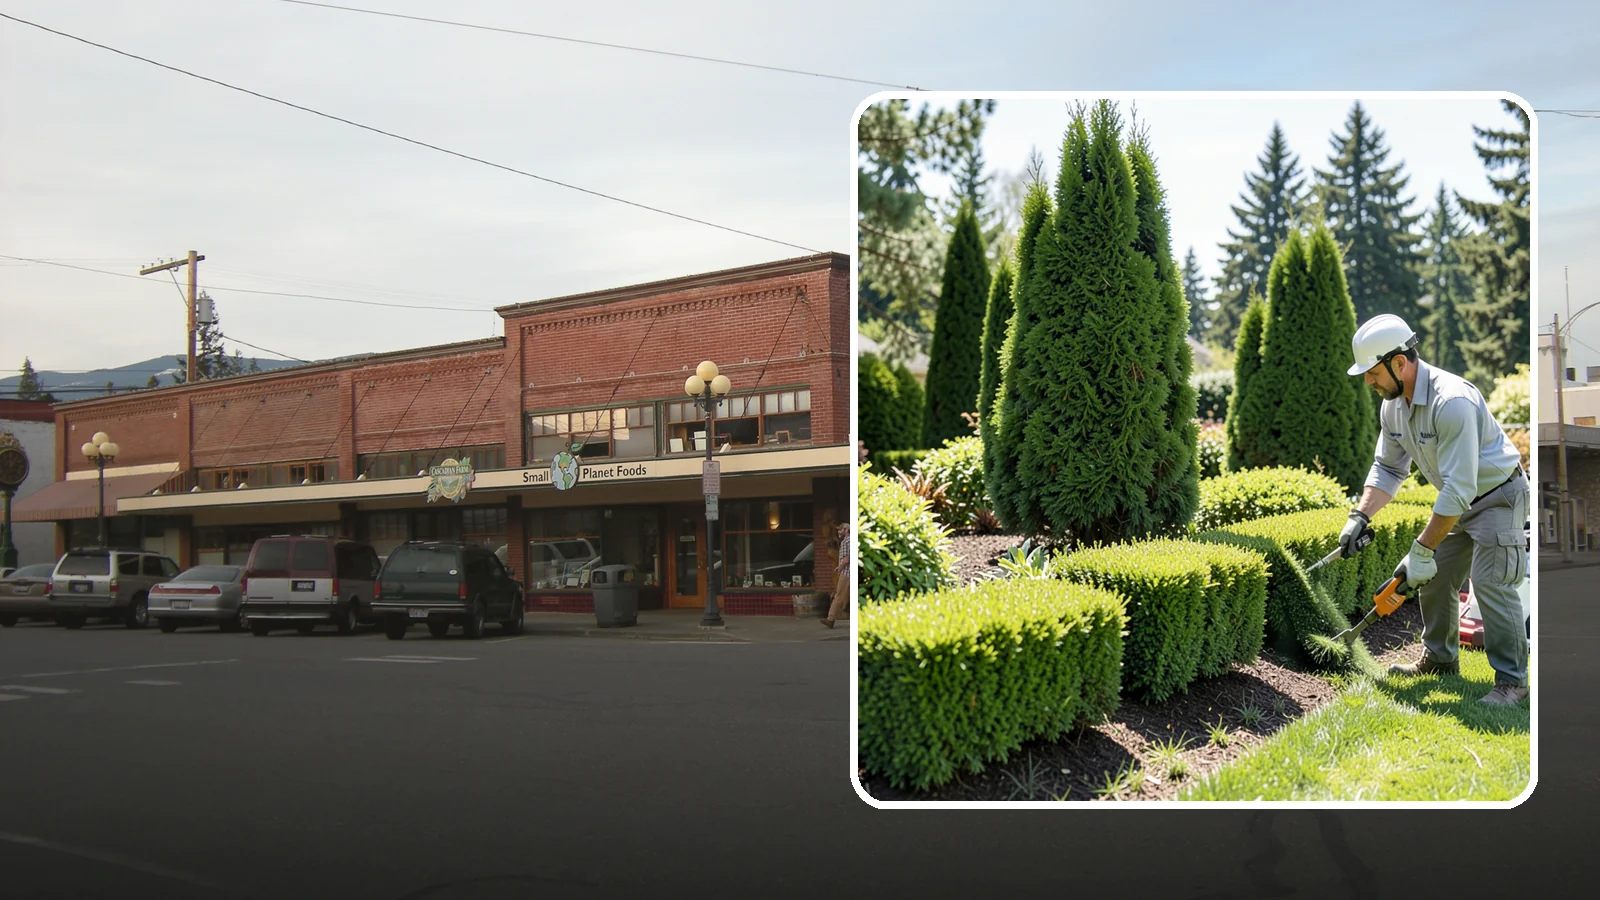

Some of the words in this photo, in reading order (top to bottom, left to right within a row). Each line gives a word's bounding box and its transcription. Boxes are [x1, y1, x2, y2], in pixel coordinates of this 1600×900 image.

[523, 471, 549, 483] Small
[583, 467, 614, 479] Planet
[617, 464, 647, 477] Foods
